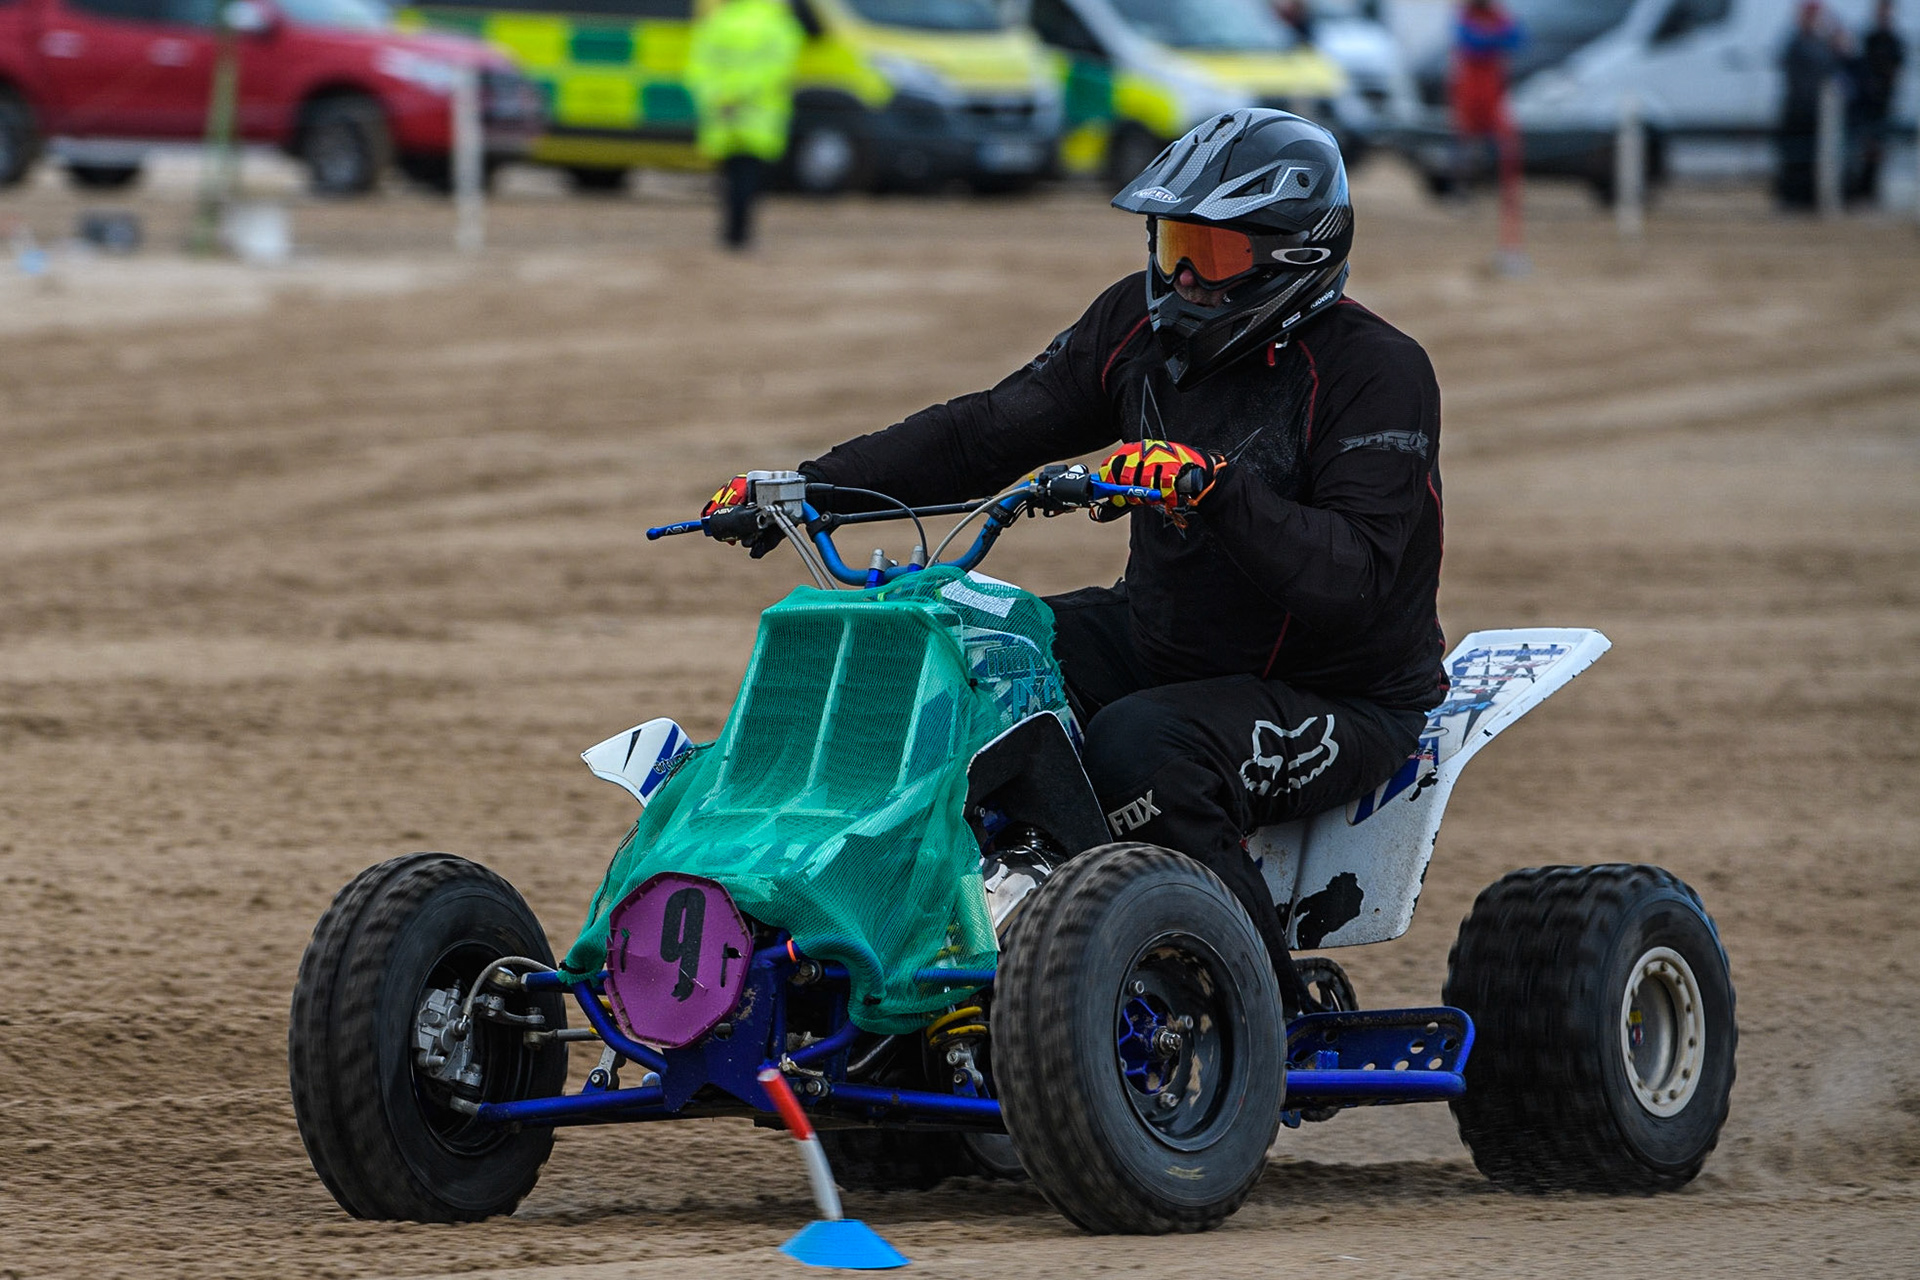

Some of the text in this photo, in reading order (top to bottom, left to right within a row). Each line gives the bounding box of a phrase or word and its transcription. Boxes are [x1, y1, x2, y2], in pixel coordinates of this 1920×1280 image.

[1058, 471, 1085, 480] ASV
[1127, 488, 1150, 496] ASV
[714, 507, 734, 516] ASV
[664, 524, 689, 536] ASV
[1107, 789, 1162, 837] FOX
[660, 887, 706, 1003] 9
